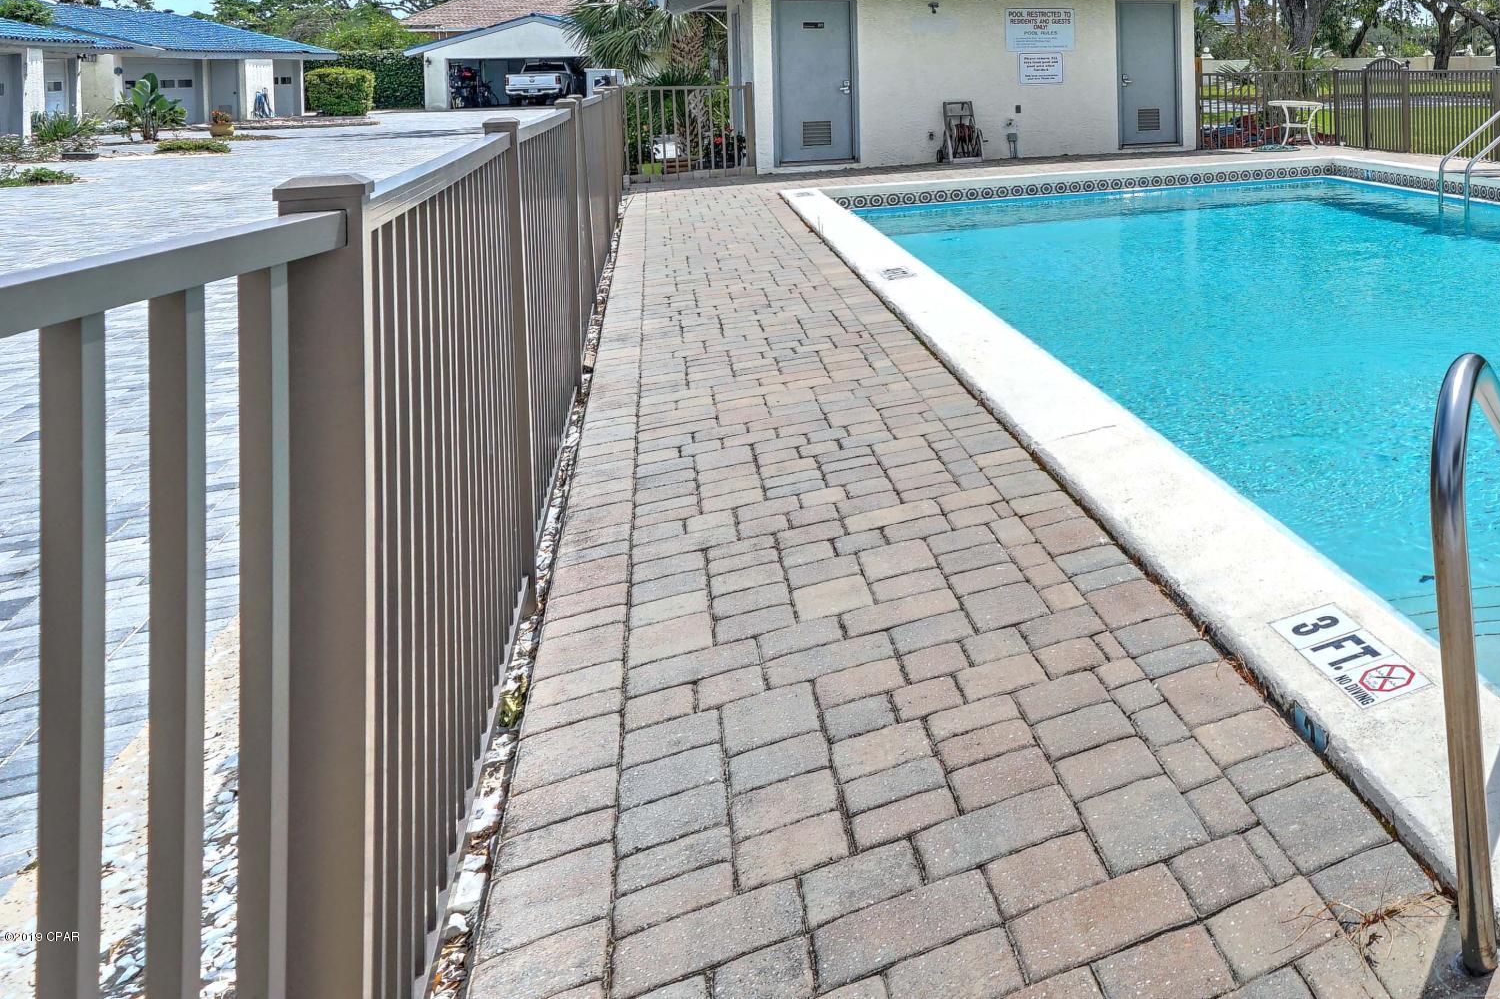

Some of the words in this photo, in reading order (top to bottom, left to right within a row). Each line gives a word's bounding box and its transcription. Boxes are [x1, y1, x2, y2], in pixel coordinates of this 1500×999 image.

[1291, 615, 1340, 636] 3
[1310, 633, 1382, 671] FT.
[1334, 674, 1353, 686] NO
[1344, 683, 1375, 706] DIVING
